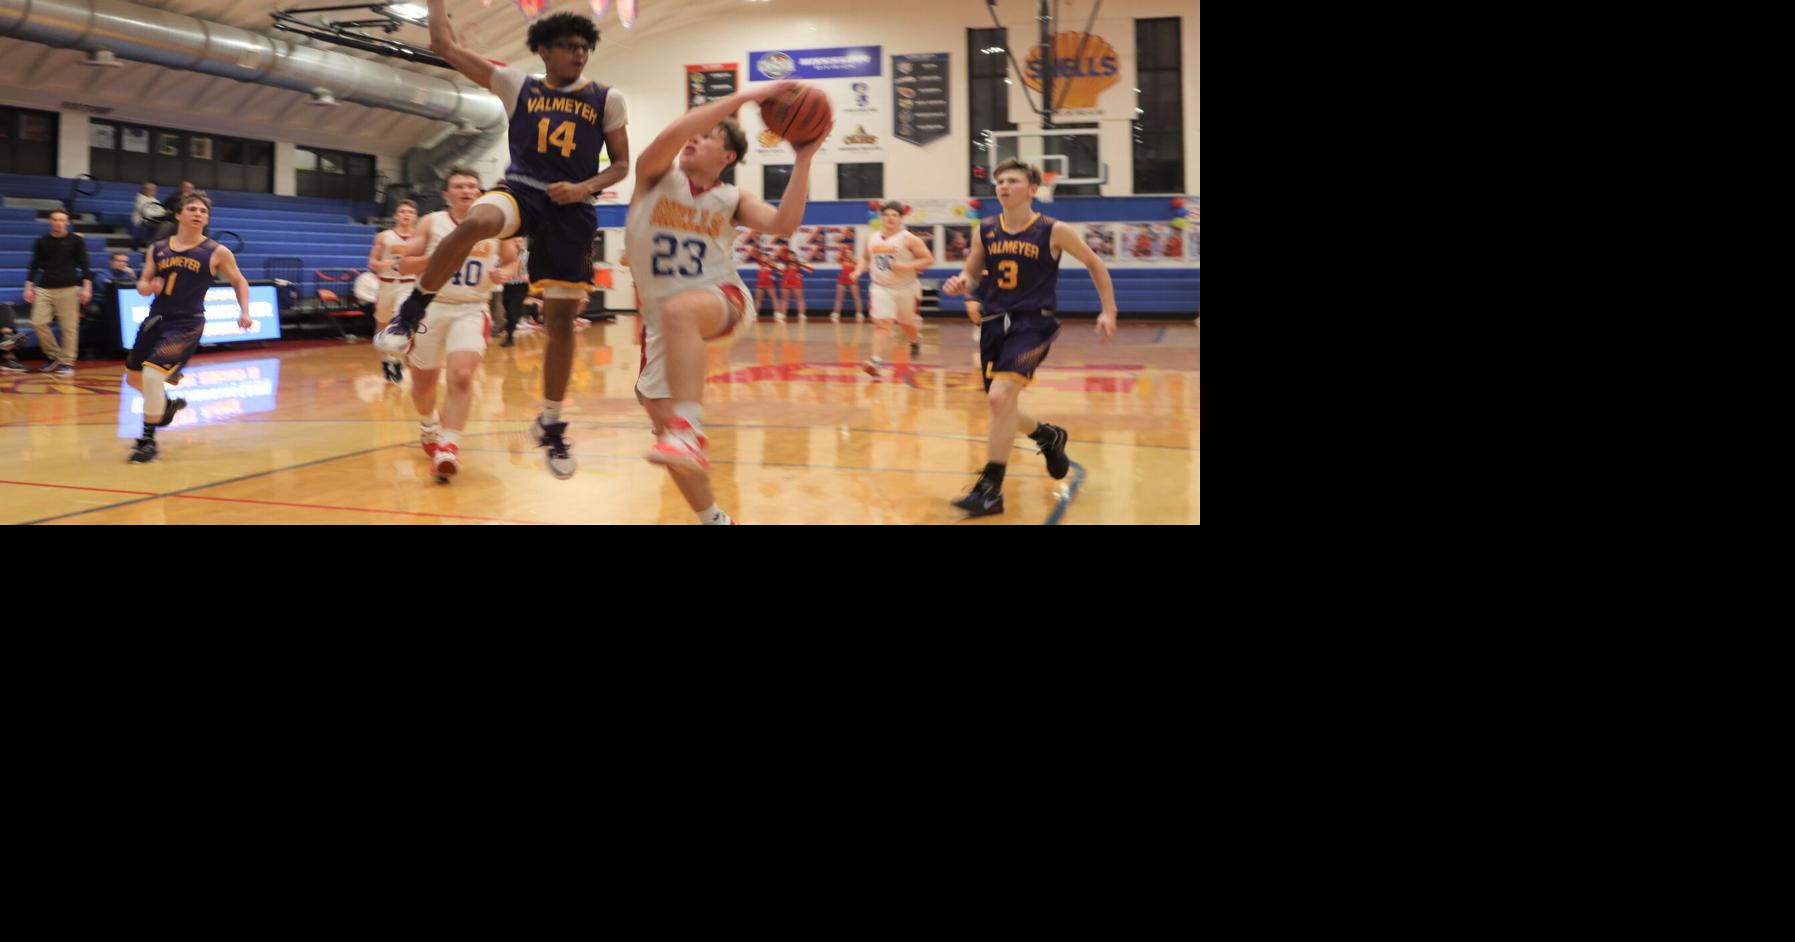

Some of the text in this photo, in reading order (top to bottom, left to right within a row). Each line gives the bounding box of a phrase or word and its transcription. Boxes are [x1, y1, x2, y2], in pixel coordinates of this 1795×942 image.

[527, 96, 598, 126] VALMEYER
[537, 117, 577, 158] 14
[652, 233, 707, 277] 23
[987, 240, 1040, 260] VALMEYER
[165, 271, 178, 296] 1
[997, 260, 1019, 289] 3
